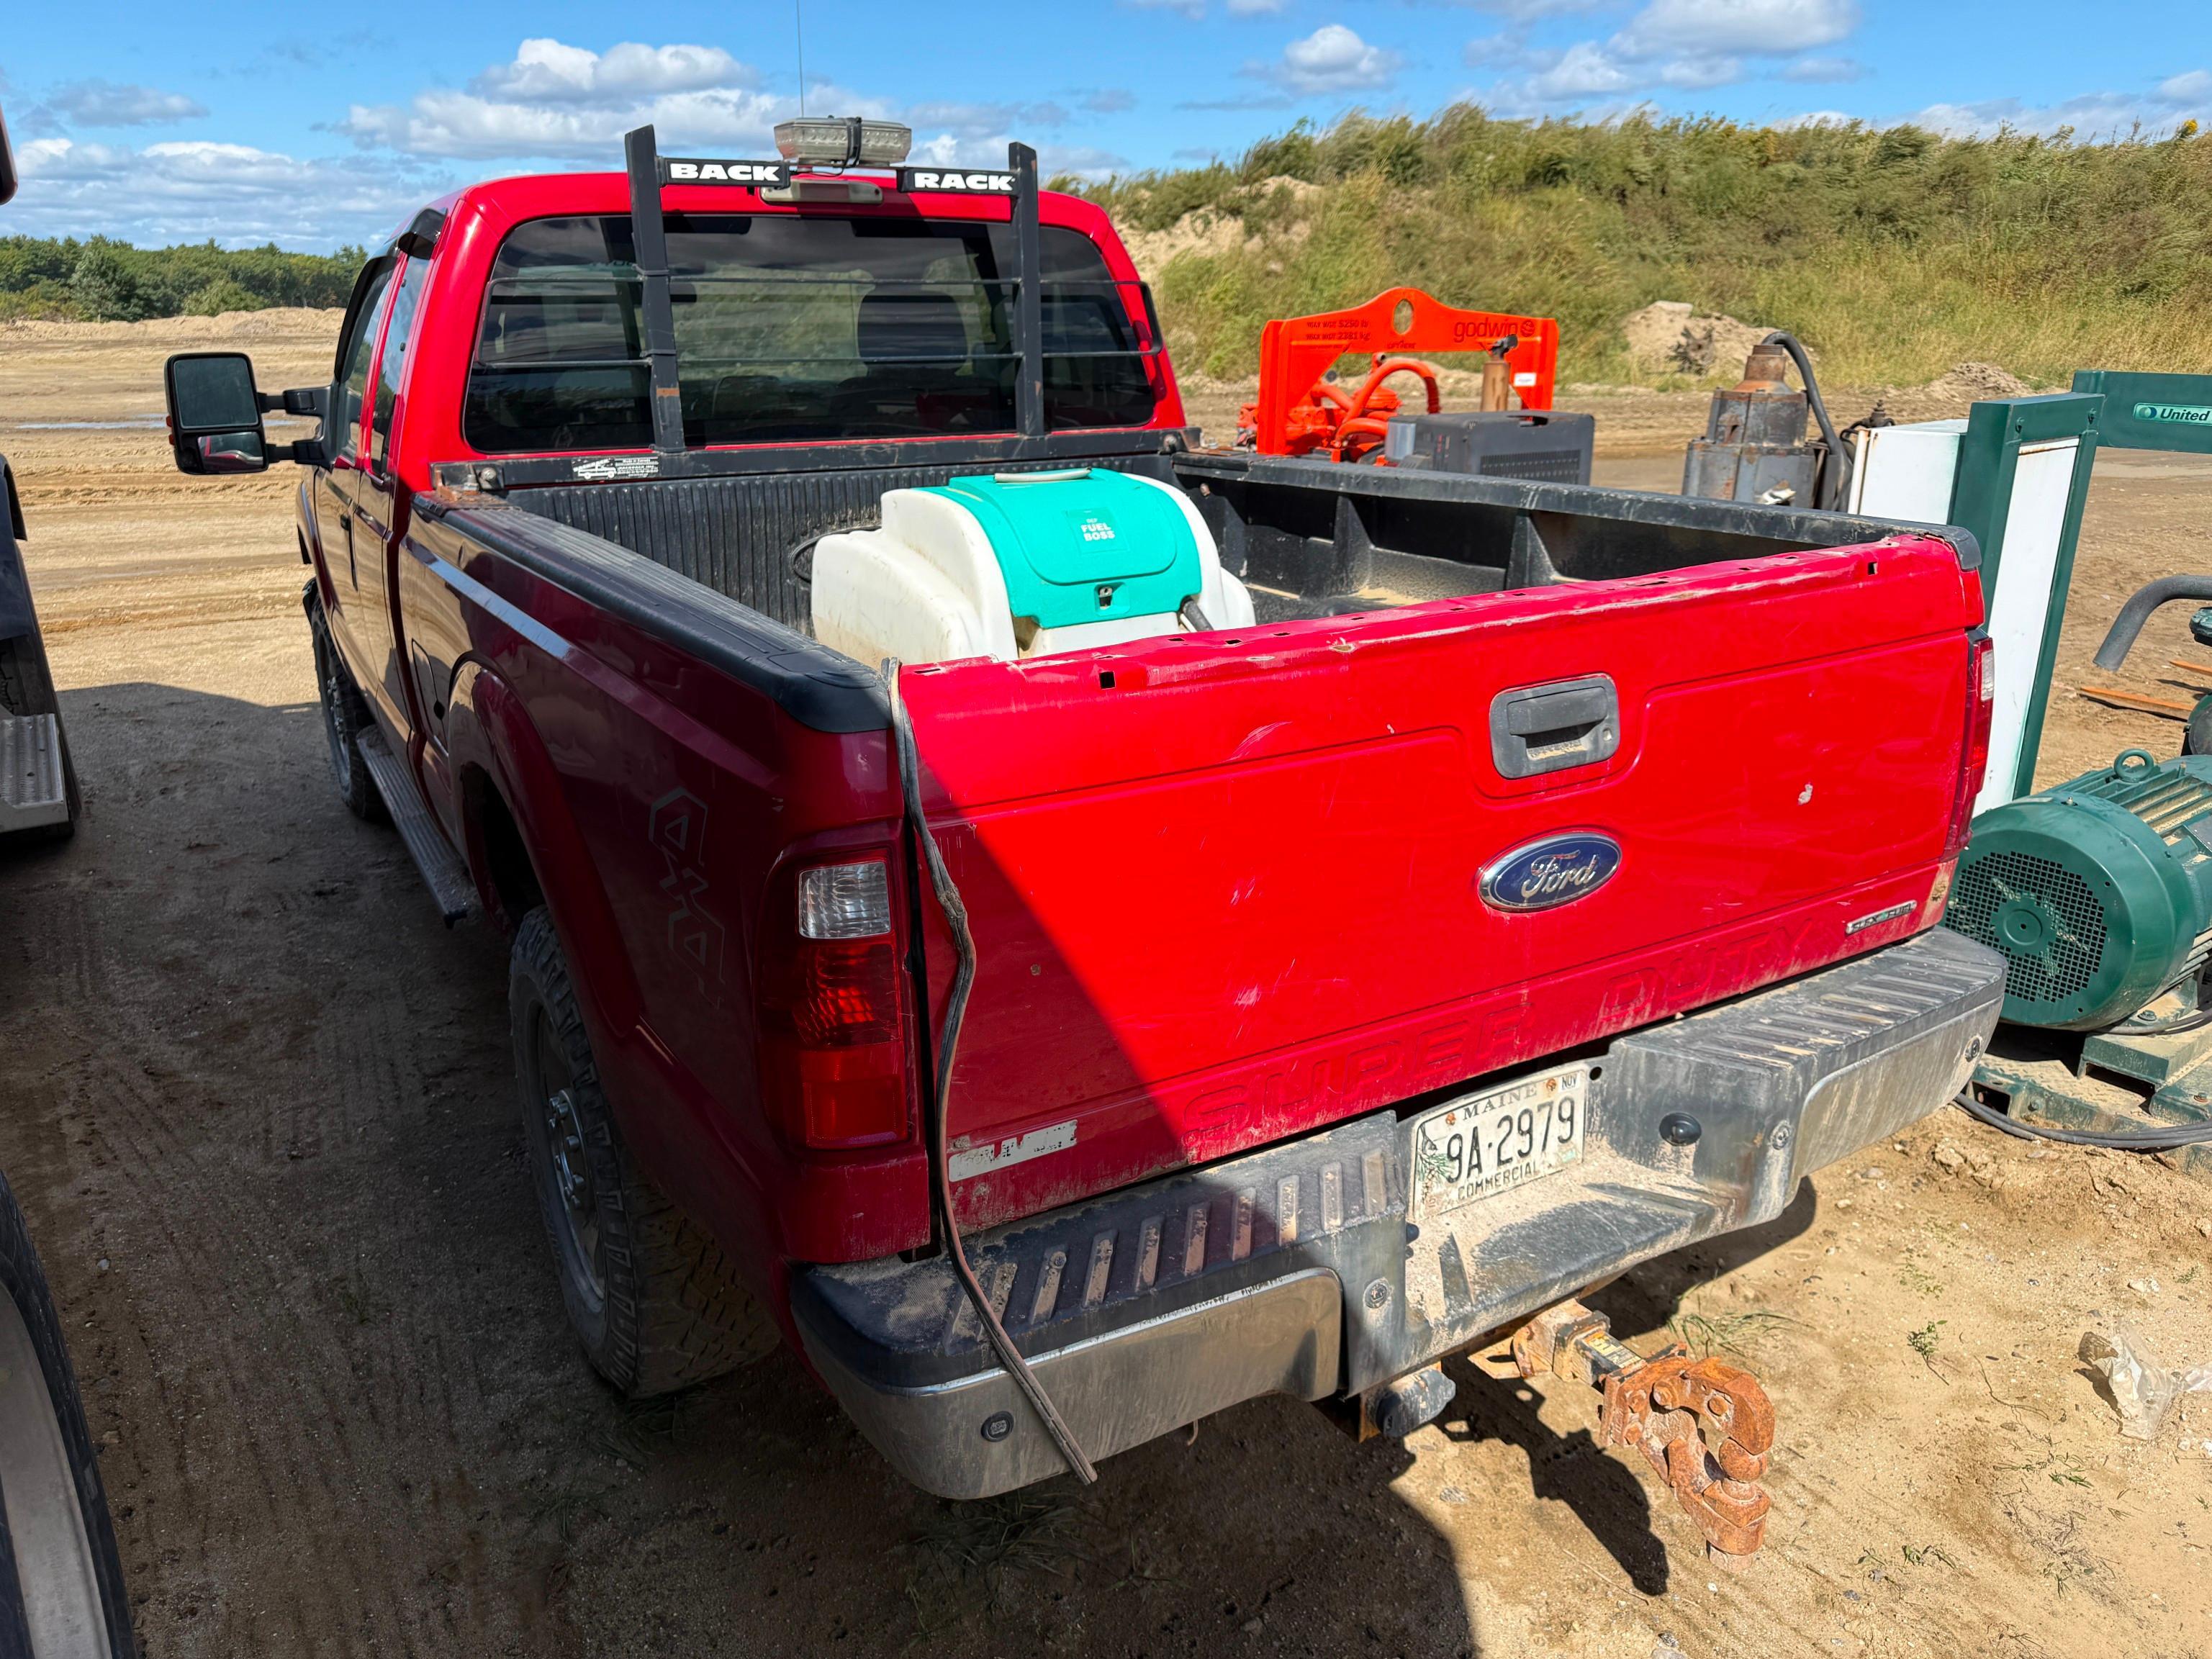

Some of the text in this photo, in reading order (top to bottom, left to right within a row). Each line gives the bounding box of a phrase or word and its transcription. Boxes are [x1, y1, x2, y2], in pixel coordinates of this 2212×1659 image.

[669, 163, 1014, 191] BACK RACK
[1453, 317, 1518, 343] godwin
[2160, 408, 2211, 422] United
[1080, 523, 1111, 533] FUEL
[1083, 530, 1115, 542] BOSS
[1521, 849, 1599, 899] Ford
[1851, 915, 1876, 931] FLEX
[1181, 918, 1814, 1146] SUPER DUTY
[1463, 1084, 1538, 1121] MAINE
[1458, 1160, 1538, 1202] COMMERCIAL
